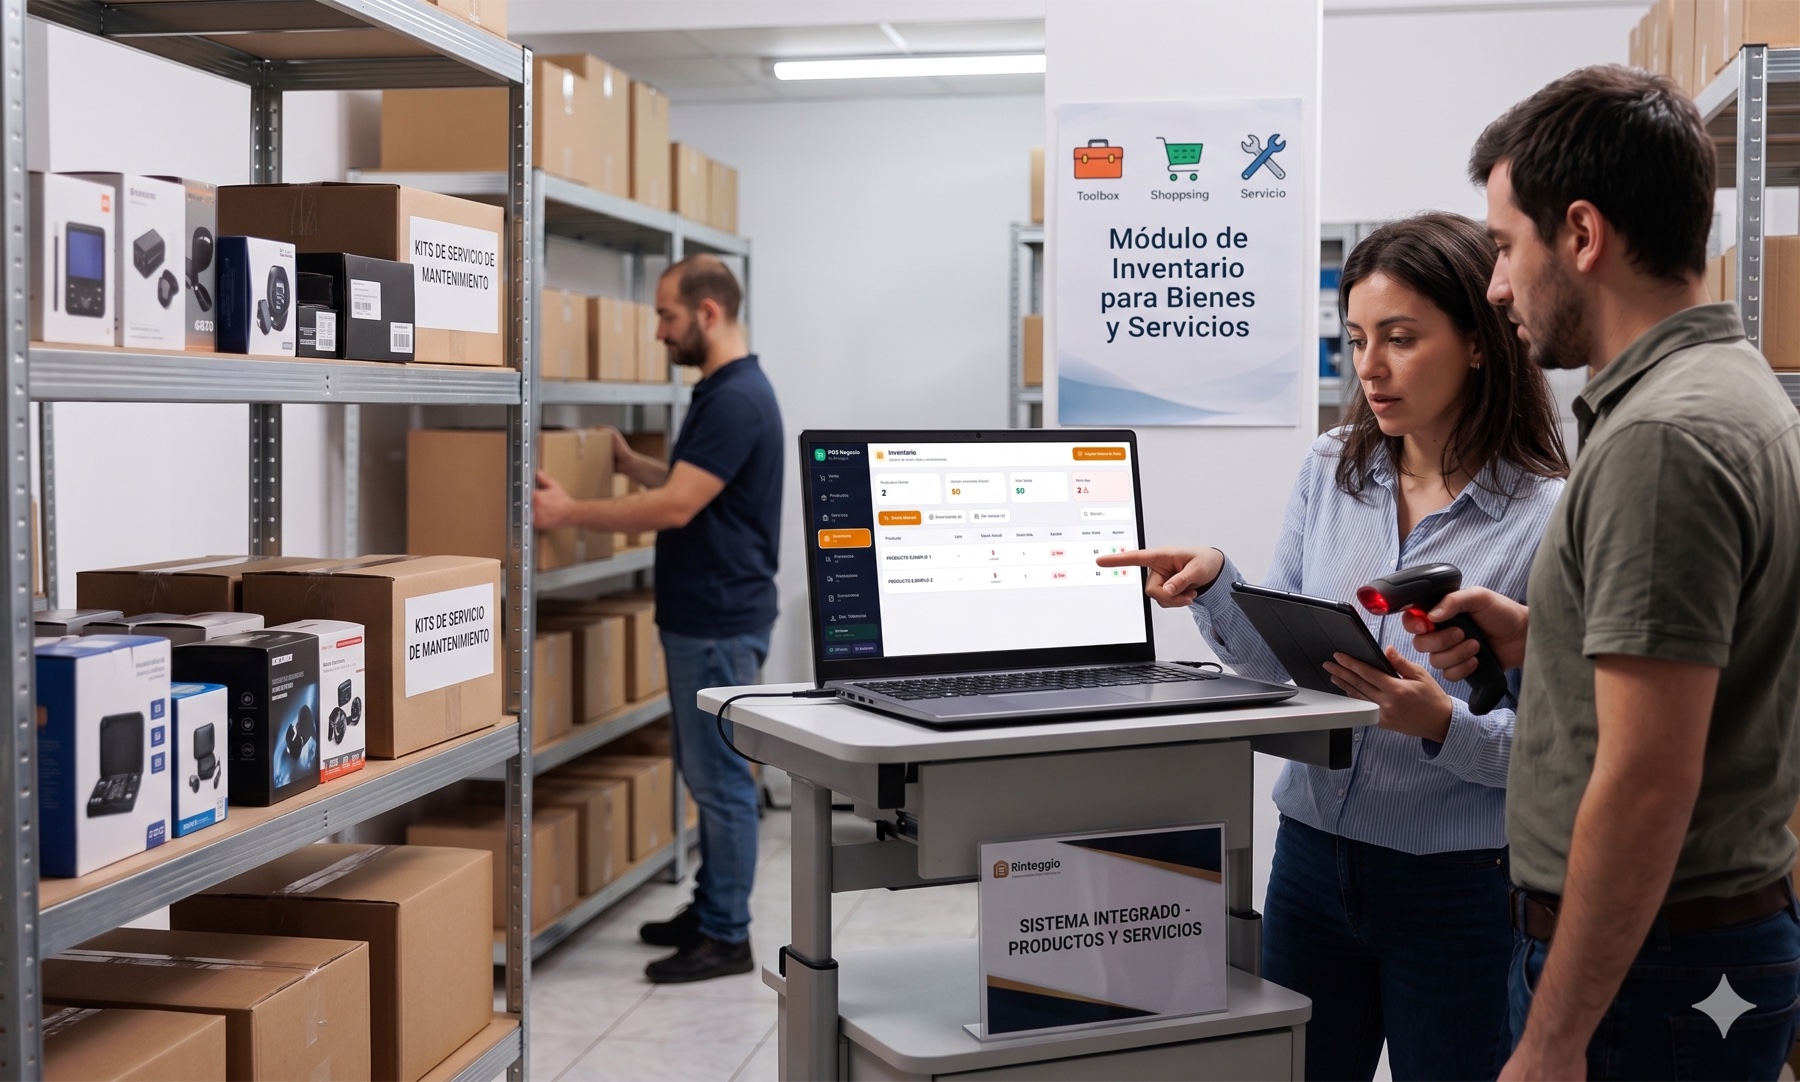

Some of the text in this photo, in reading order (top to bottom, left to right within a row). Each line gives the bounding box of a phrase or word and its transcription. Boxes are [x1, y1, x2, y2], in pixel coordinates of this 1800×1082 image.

[1077, 190, 1120, 201] Toolbox
[1150, 189, 1210, 202] Shoppsing
[1240, 188, 1286, 199] Servicio
[1109, 226, 1248, 250] Módulo de
[415, 239, 495, 267] KITS DE SERVICIO DE
[422, 266, 489, 290] MANTENIMIENTO
[1112, 256, 1245, 279] Inventario
[1101, 286, 1256, 314] para Bienes
[1106, 315, 1250, 343] y Servicios
[881, 489, 887, 497] 2
[951, 488, 961, 496] $0
[1016, 487, 1025, 495] $0
[415, 605, 485, 634] KITS DE SERVICIO
[409, 628, 490, 661] DE MANTENIMIENTO
[1011, 858, 1061, 872] Rinteggio
[1019, 912, 1090, 933] SISTEMA
[1093, 903, 1181, 926] INTEGRADO
[1008, 921, 1203, 956] PRODUCTOS Y SERVICIOS
